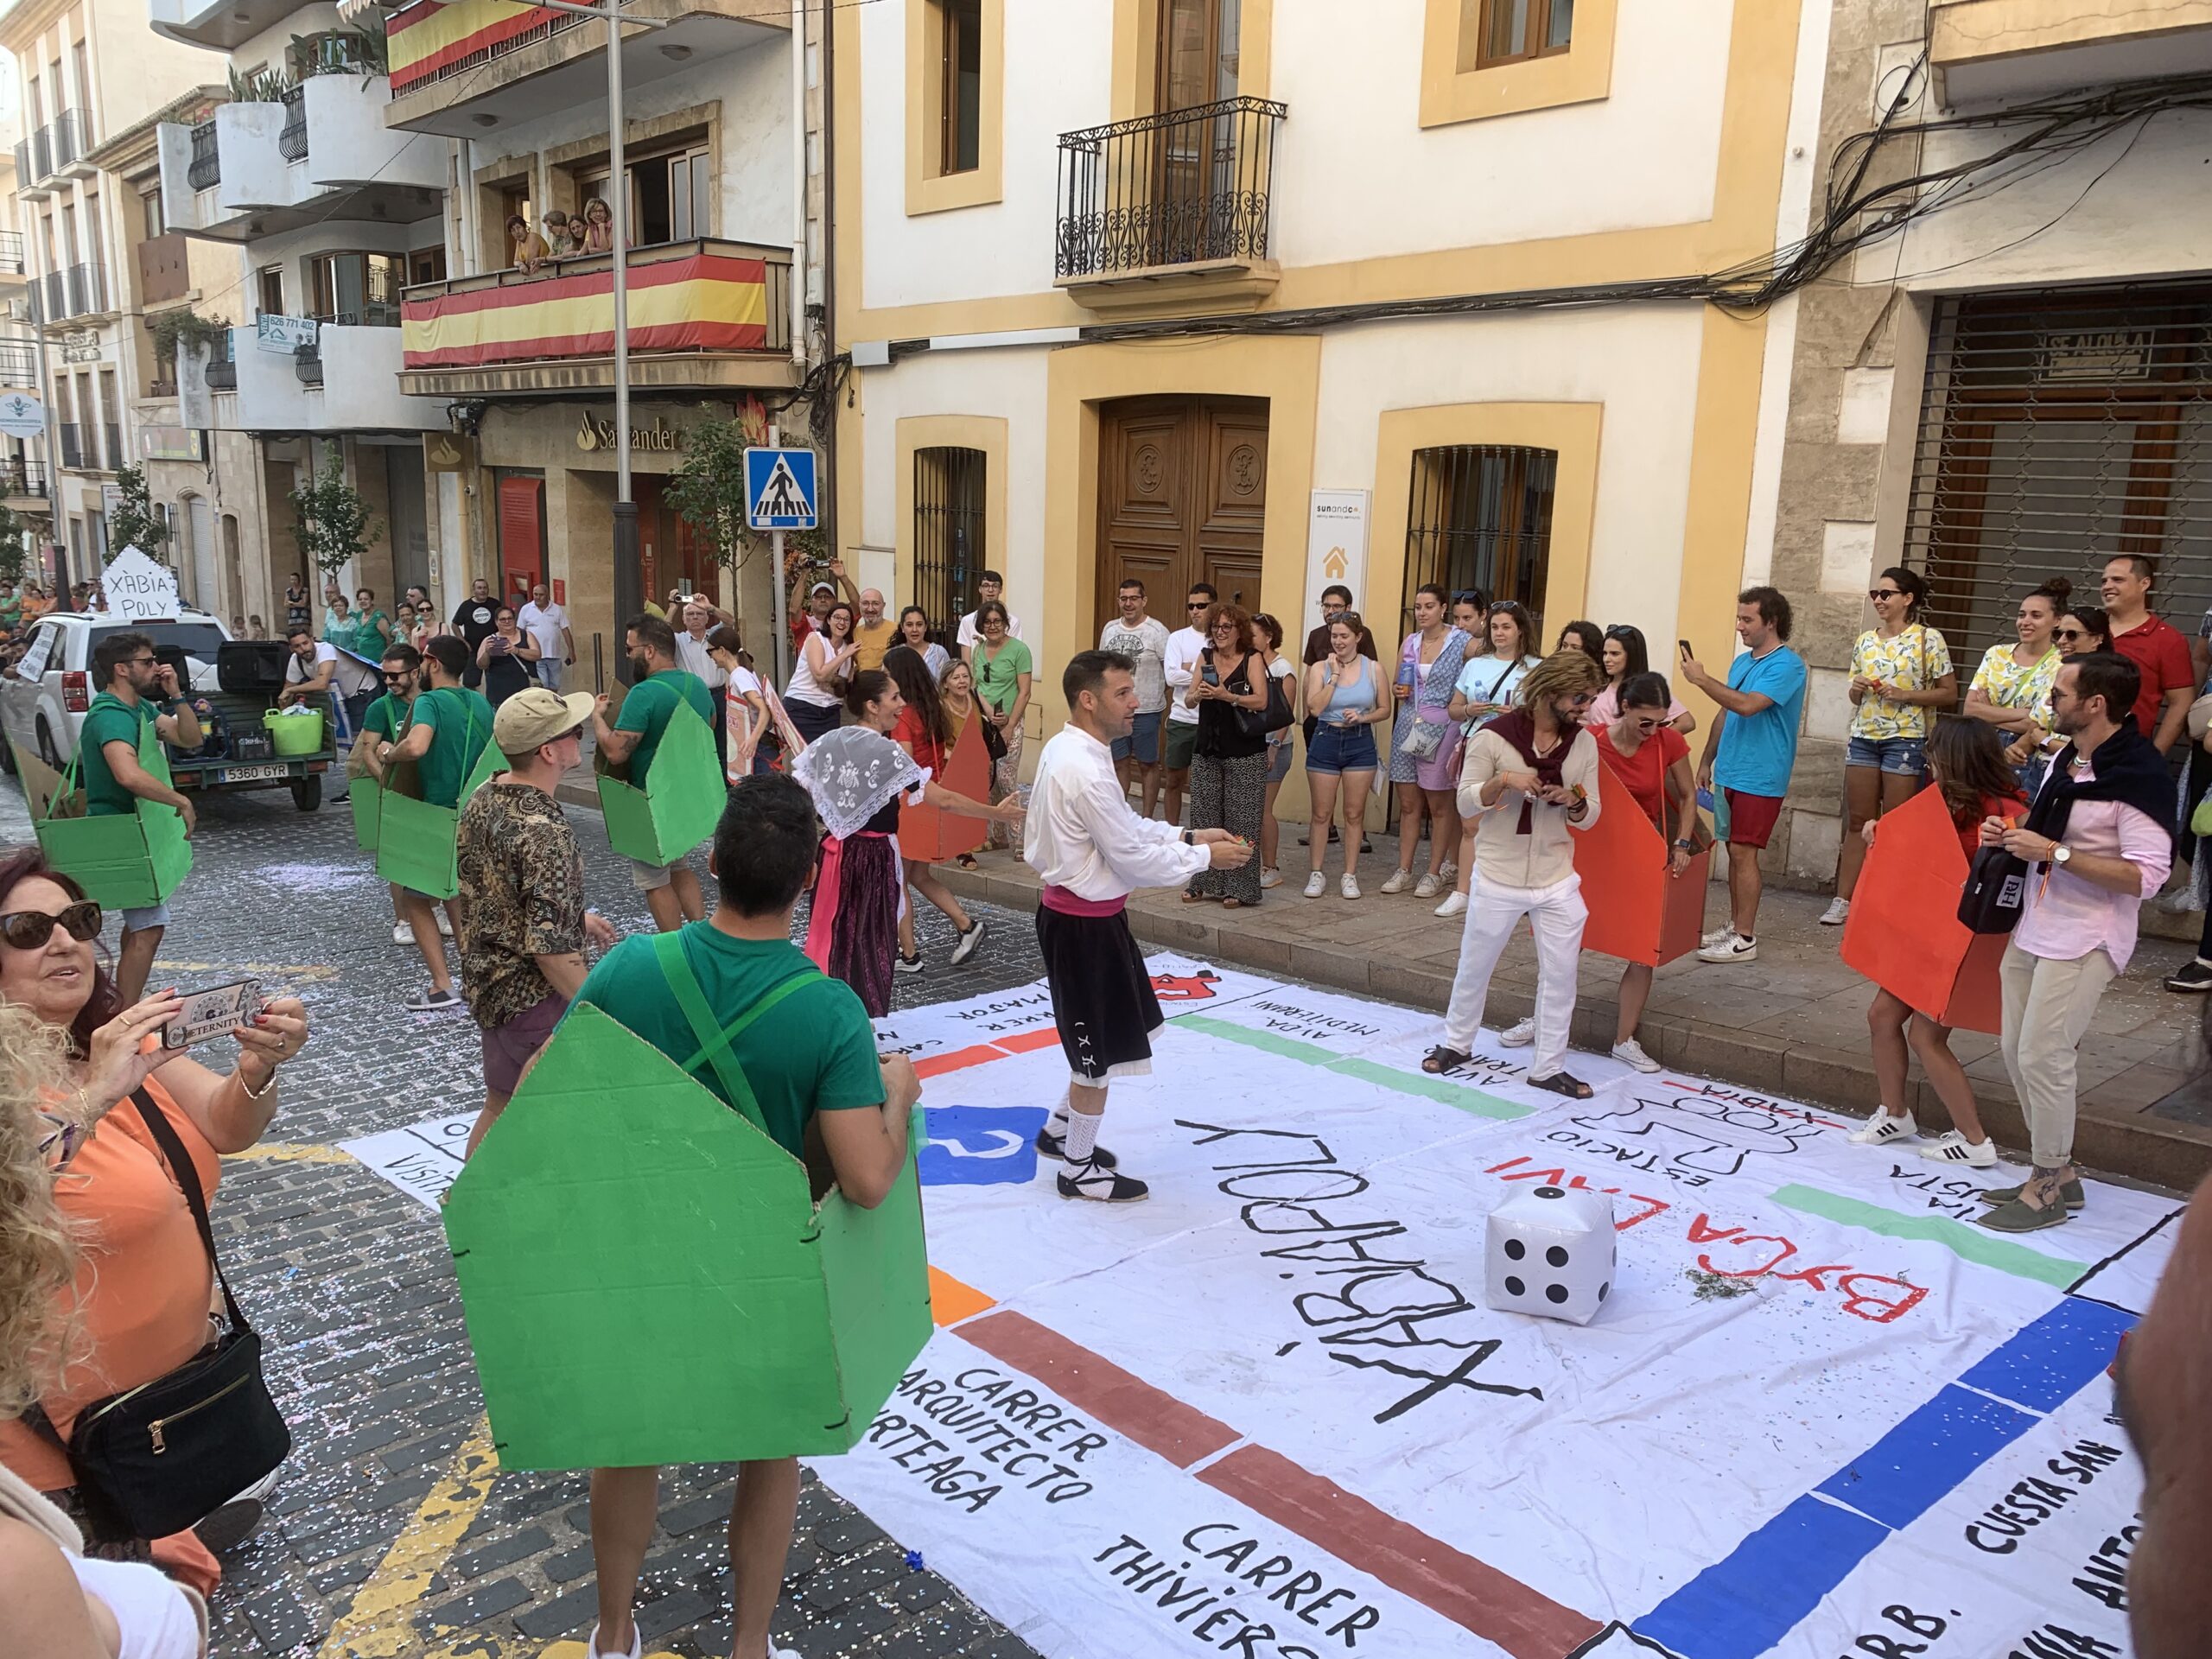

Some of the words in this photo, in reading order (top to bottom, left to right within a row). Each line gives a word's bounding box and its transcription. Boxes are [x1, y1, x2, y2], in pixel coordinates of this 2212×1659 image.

[270, 316, 284, 327] 626
[286, 318, 299, 329] 771
[301, 321, 315, 331] 402
[2049, 335, 2071, 357] SE
[598, 416, 677, 450] Saander
[121, 599, 168, 619] POLY
[228, 767, 259, 780] 5360
[264, 765, 286, 778] GYR
[944, 994, 1050, 1020] MAJOR
[976, 1010, 1056, 1032] RRER
[954, 1368, 1109, 1463] CARRER
[896, 1368, 1093, 1503] ARQUITECTO
[1964, 1476, 2078, 1554] CUESTA
[2047, 1439, 2123, 1484] SAN
[1182, 1523, 1380, 1648] CARRER
